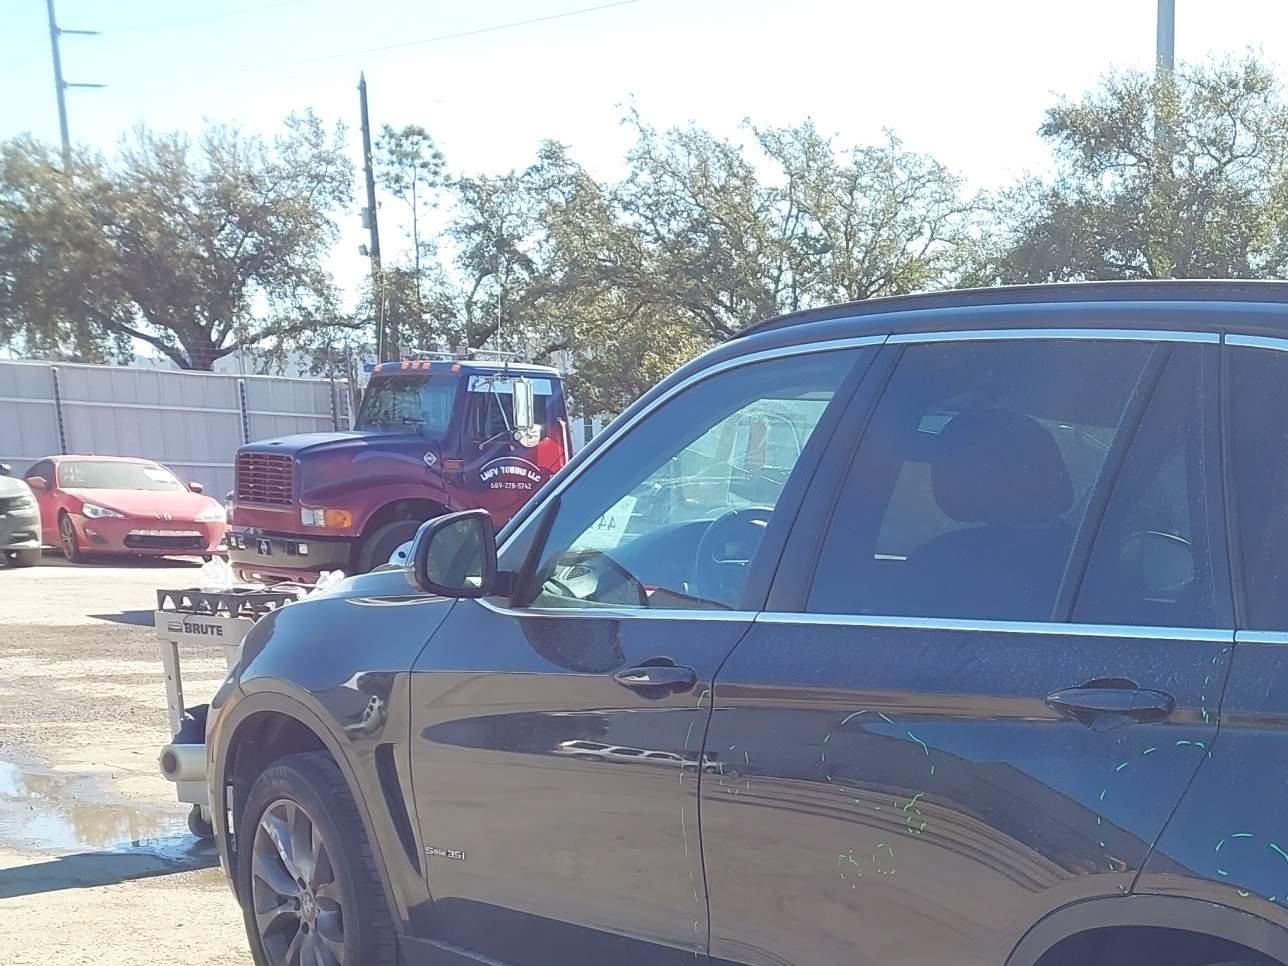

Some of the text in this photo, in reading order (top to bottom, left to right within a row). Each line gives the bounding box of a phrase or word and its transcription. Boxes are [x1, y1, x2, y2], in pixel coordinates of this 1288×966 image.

[499, 465, 527, 477] TOWING
[527, 470, 542, 482] LLC
[184, 622, 223, 636] BRUTE
